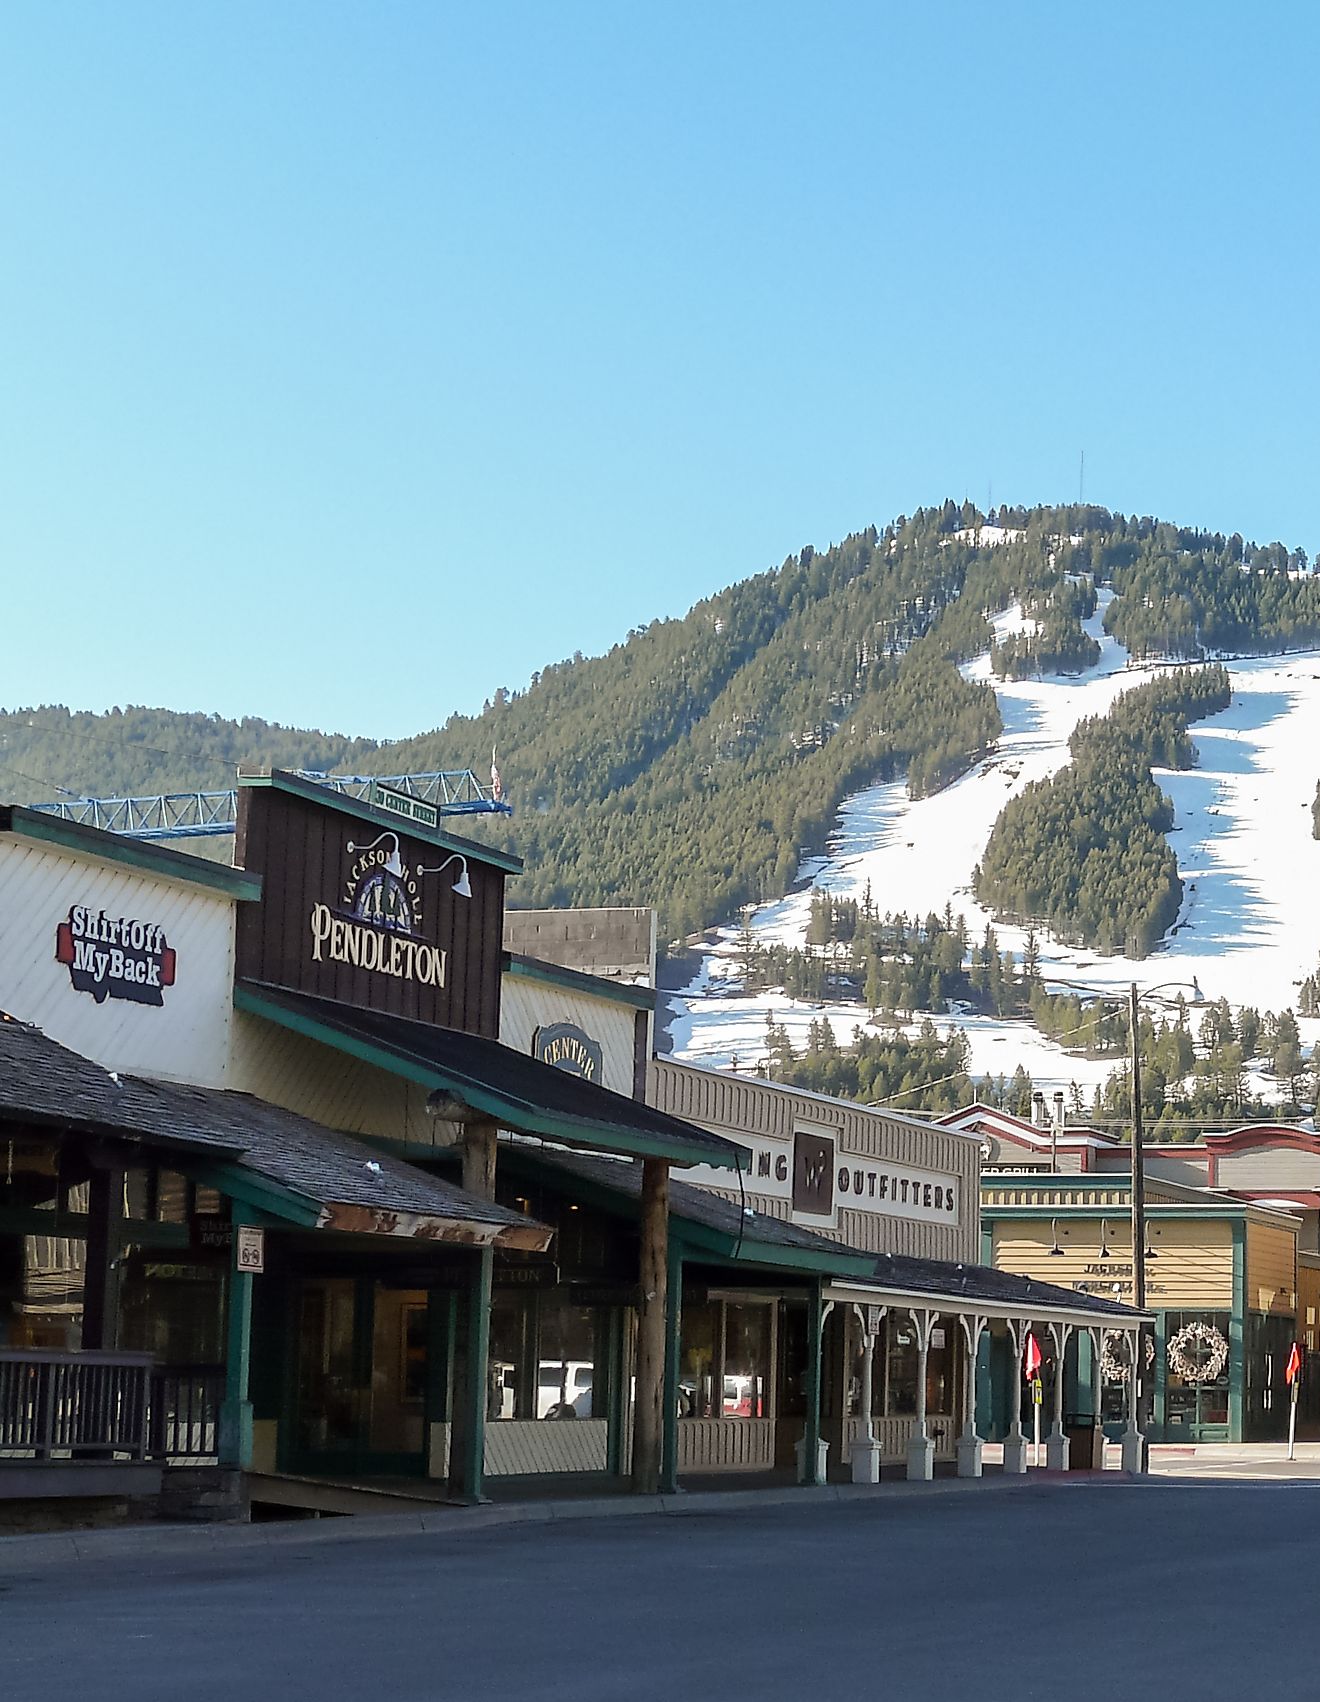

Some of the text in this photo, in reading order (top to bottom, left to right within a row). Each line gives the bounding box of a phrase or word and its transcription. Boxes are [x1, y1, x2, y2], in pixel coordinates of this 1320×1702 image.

[310, 902, 448, 989] PENDLETON
[543, 1036, 596, 1081] CENTER
[837, 1166, 954, 1213] OUTFITTERS
